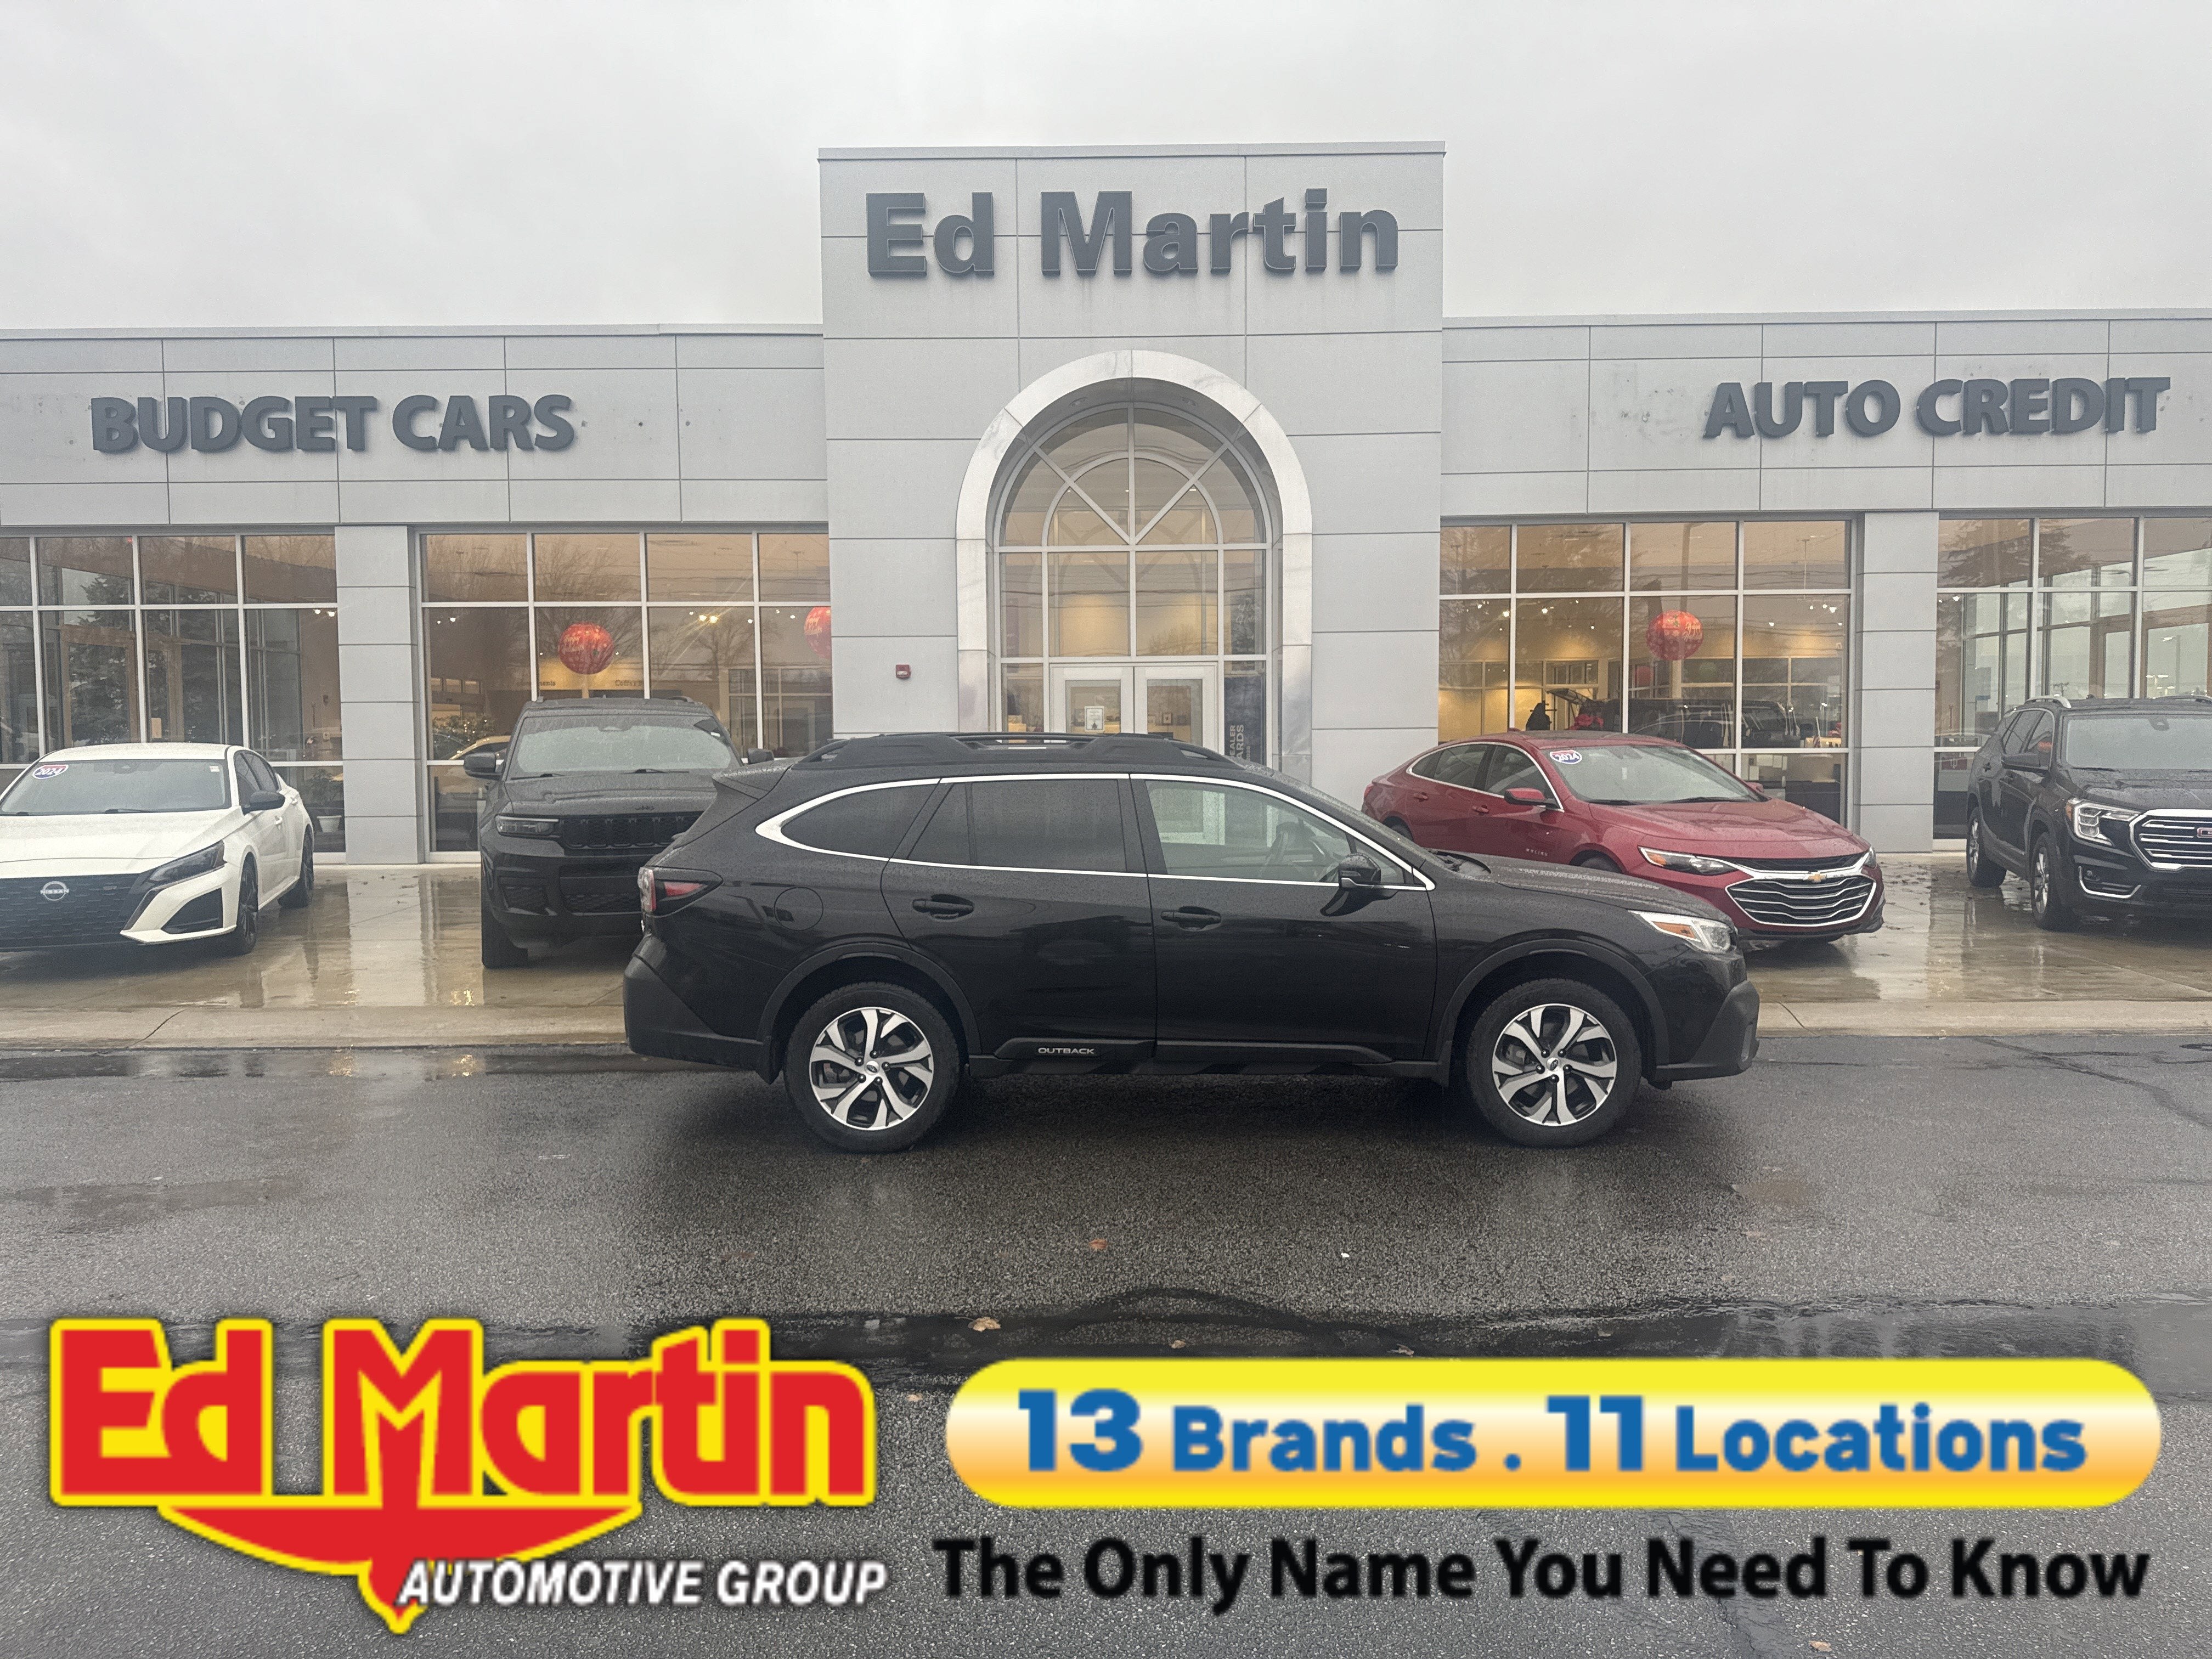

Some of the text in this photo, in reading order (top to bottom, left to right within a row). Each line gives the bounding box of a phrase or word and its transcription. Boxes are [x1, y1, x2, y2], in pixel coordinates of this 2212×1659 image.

[866, 188, 1398, 276] Ed Martin
[91, 393, 575, 453] BUDGET CARS
[1703, 376, 2171, 438] AUTO CREDIT
[1236, 724, 1245, 759] ARDS
[1554, 752, 1580, 761] 2024
[34, 768, 66, 776] 2024
